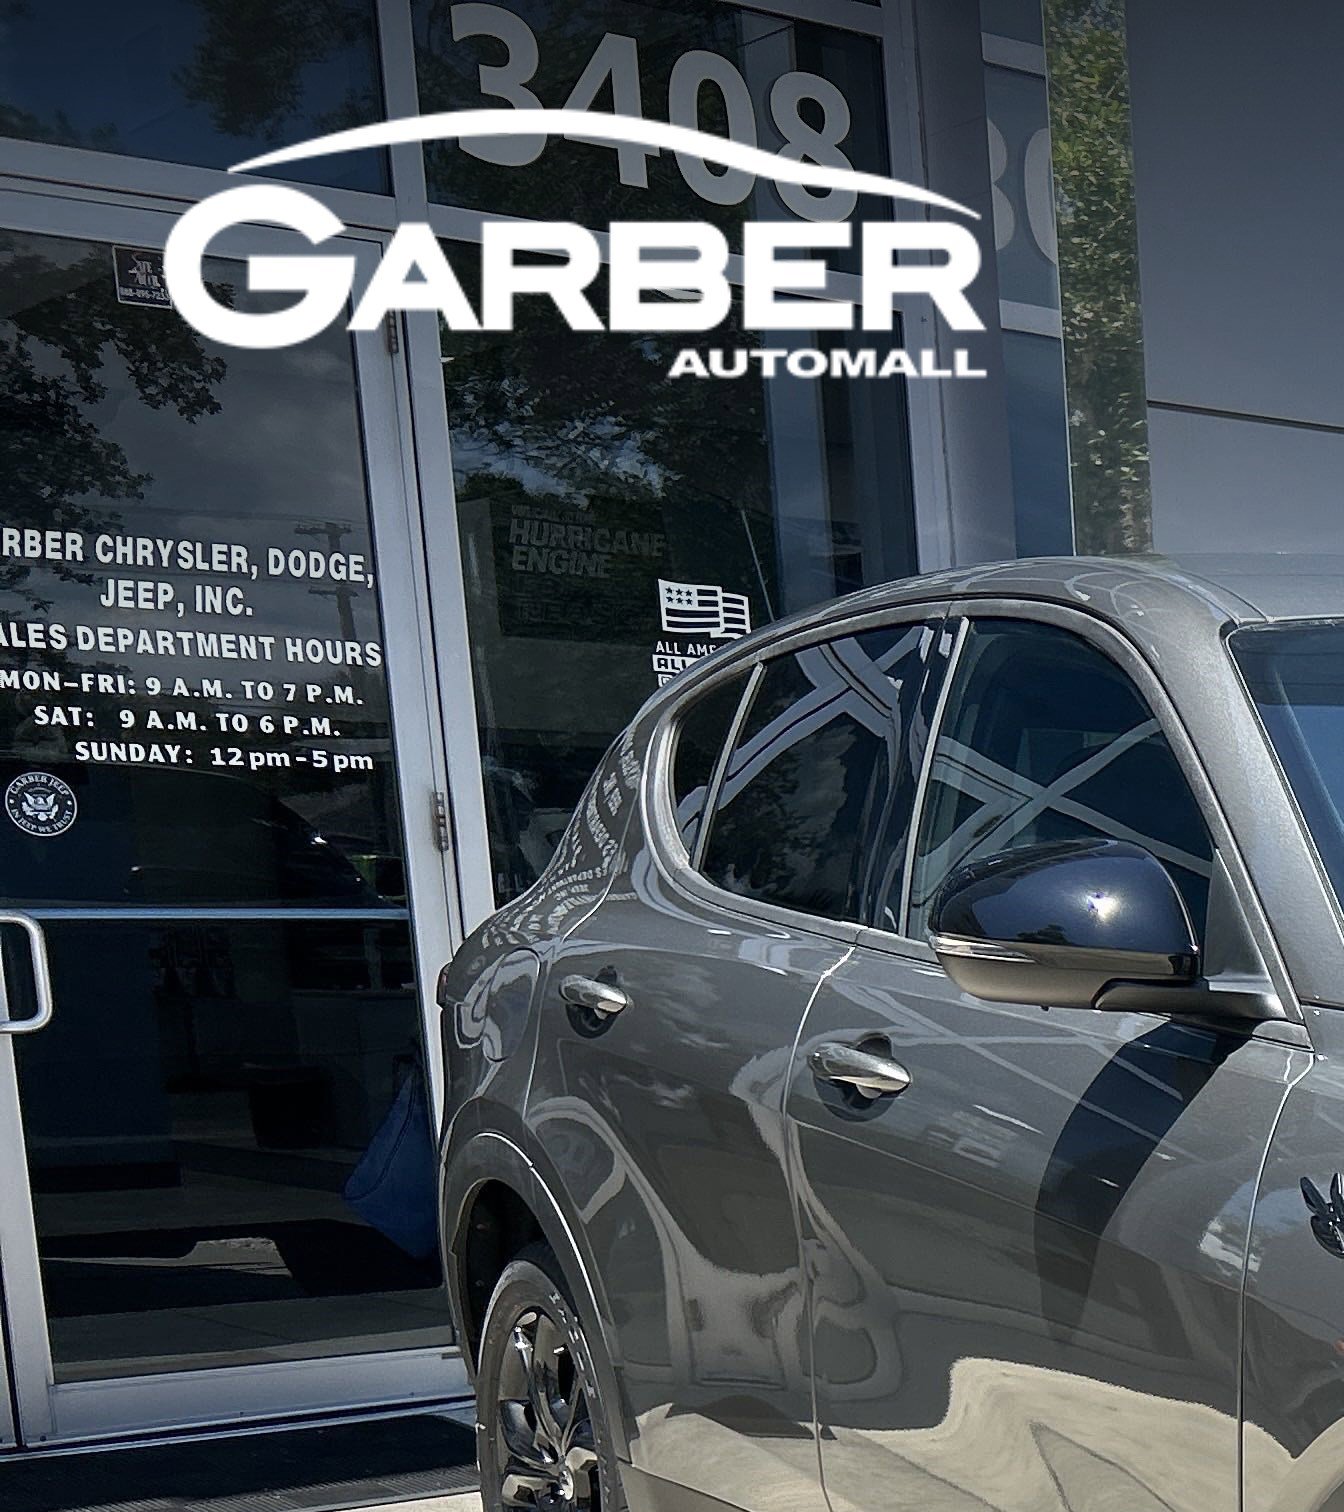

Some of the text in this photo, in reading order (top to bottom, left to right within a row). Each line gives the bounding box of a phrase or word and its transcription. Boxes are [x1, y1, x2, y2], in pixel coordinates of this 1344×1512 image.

[448, 2, 858, 224] 3408
[95, 534, 258, 580] CHRYSLER,
[268, 547, 374, 588] DODGE,
[100, 578, 253, 618] JEEP, INC.
[76, 625, 275, 661] DEPARTMENT
[286, 638, 382, 667] HOURS
[655, 640, 681, 655] ALL
[145, 676, 161, 695] 9
[172, 678, 233, 699] A.M.
[241, 681, 274, 701] TO
[283, 683, 296, 702] 7
[306, 684, 363, 705] P.M.
[34, 705, 341, 737] SAT: 9 A.M. TO 6 P.M.
[75, 741, 192, 764] SUNDAY:
